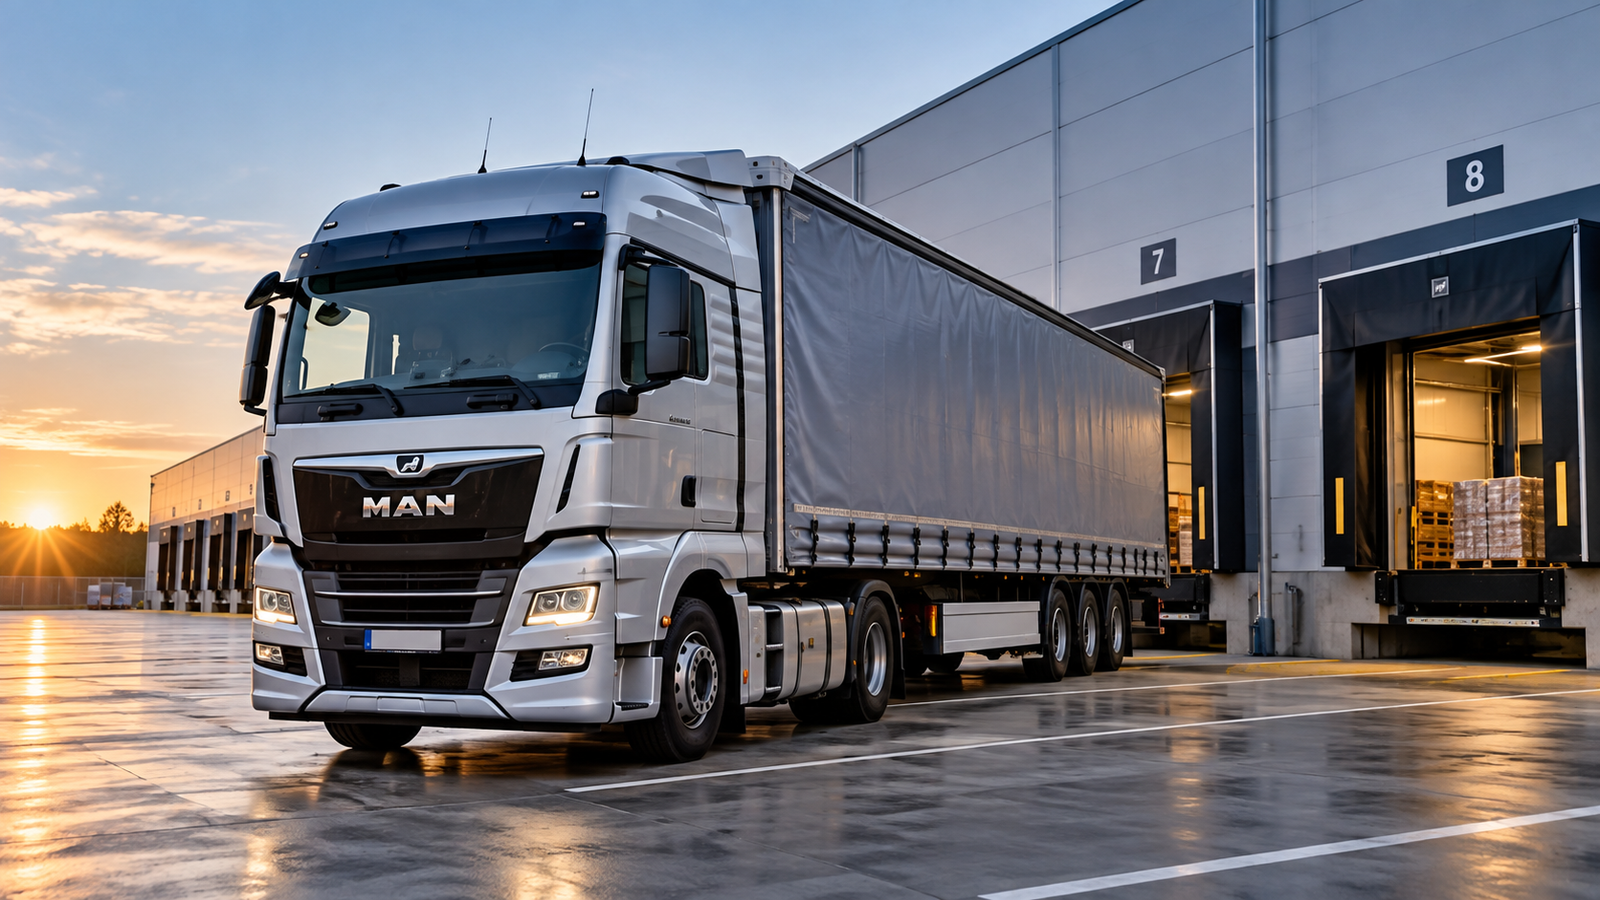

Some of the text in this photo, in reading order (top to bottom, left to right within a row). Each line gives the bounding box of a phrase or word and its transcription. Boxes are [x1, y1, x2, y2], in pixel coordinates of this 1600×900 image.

[1465, 159, 1485, 193] 8
[1152, 247, 1165, 275] 7
[362, 494, 456, 518] MAN
